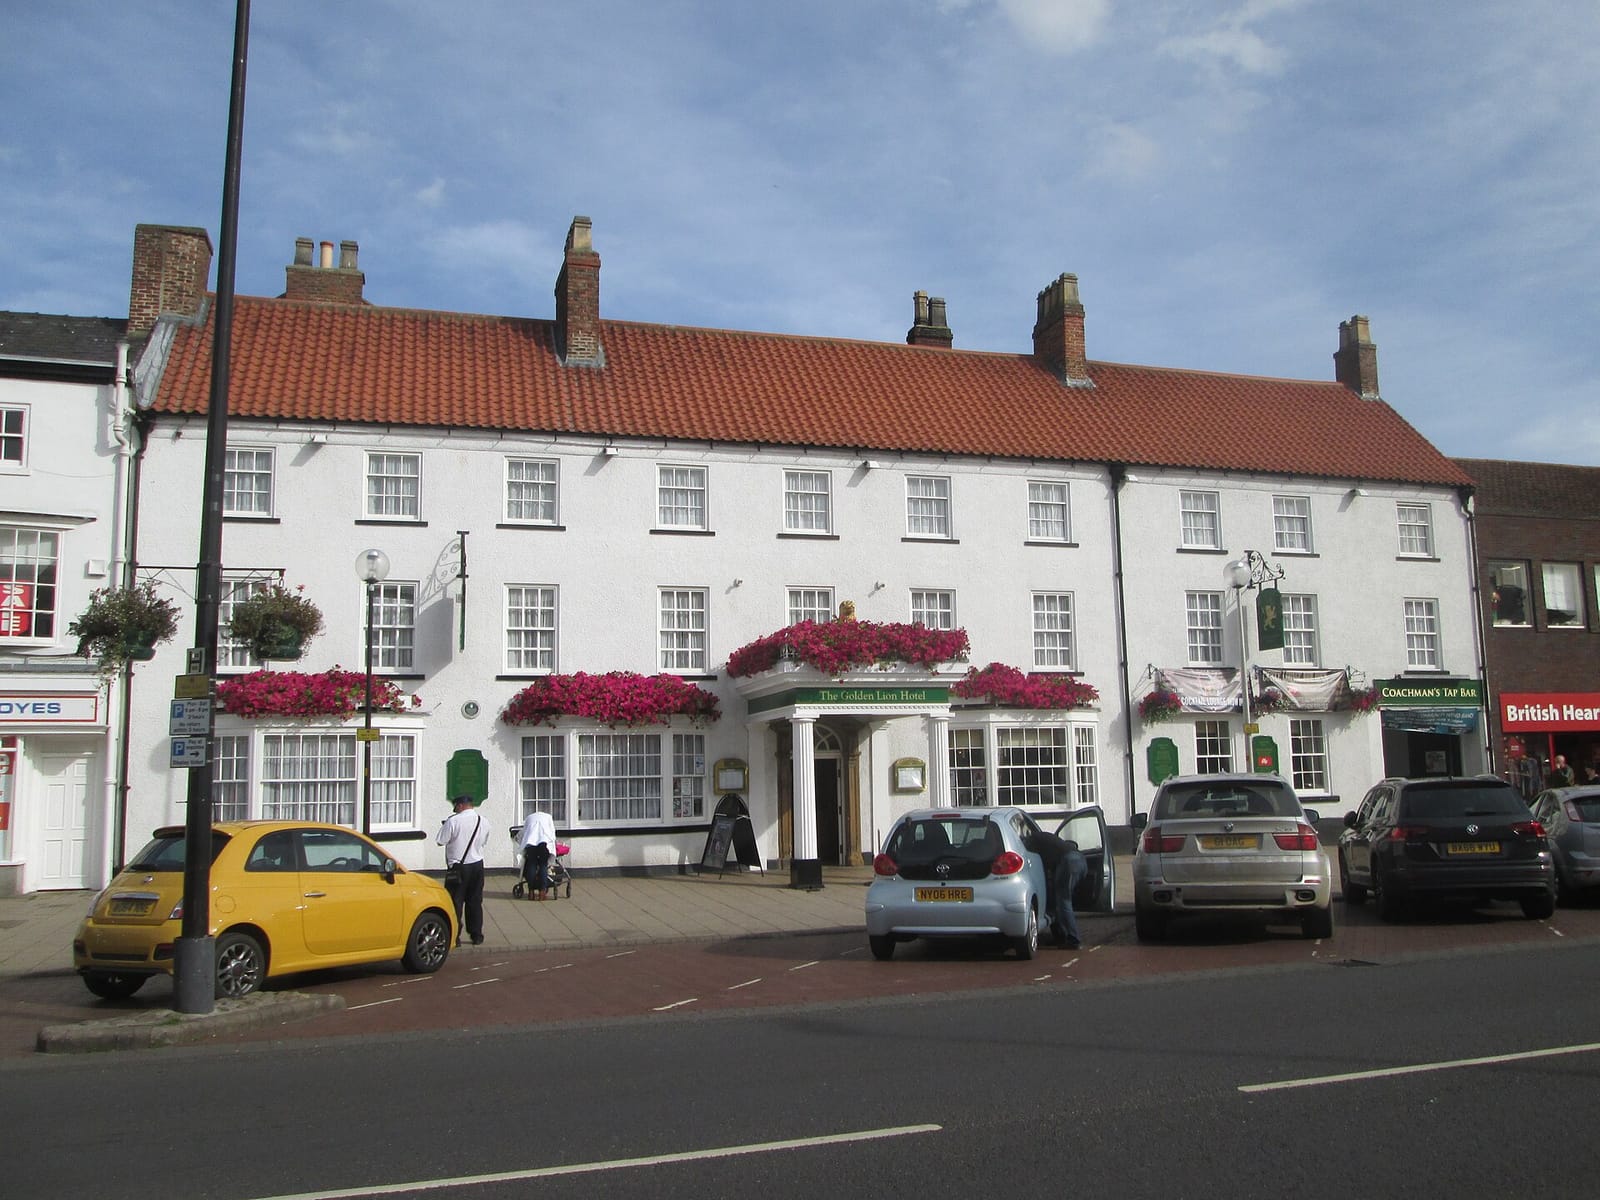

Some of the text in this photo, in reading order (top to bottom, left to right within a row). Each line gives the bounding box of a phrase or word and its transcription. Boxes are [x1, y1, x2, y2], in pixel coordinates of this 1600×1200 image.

[821, 690, 926, 700] The Golden Lion Hotel
[1382, 687, 1477, 698] COACHMAN'S TAP BAR
[1506, 703, 1600, 721] British Hear
[920, 890, 967, 900] NY06 HRE
